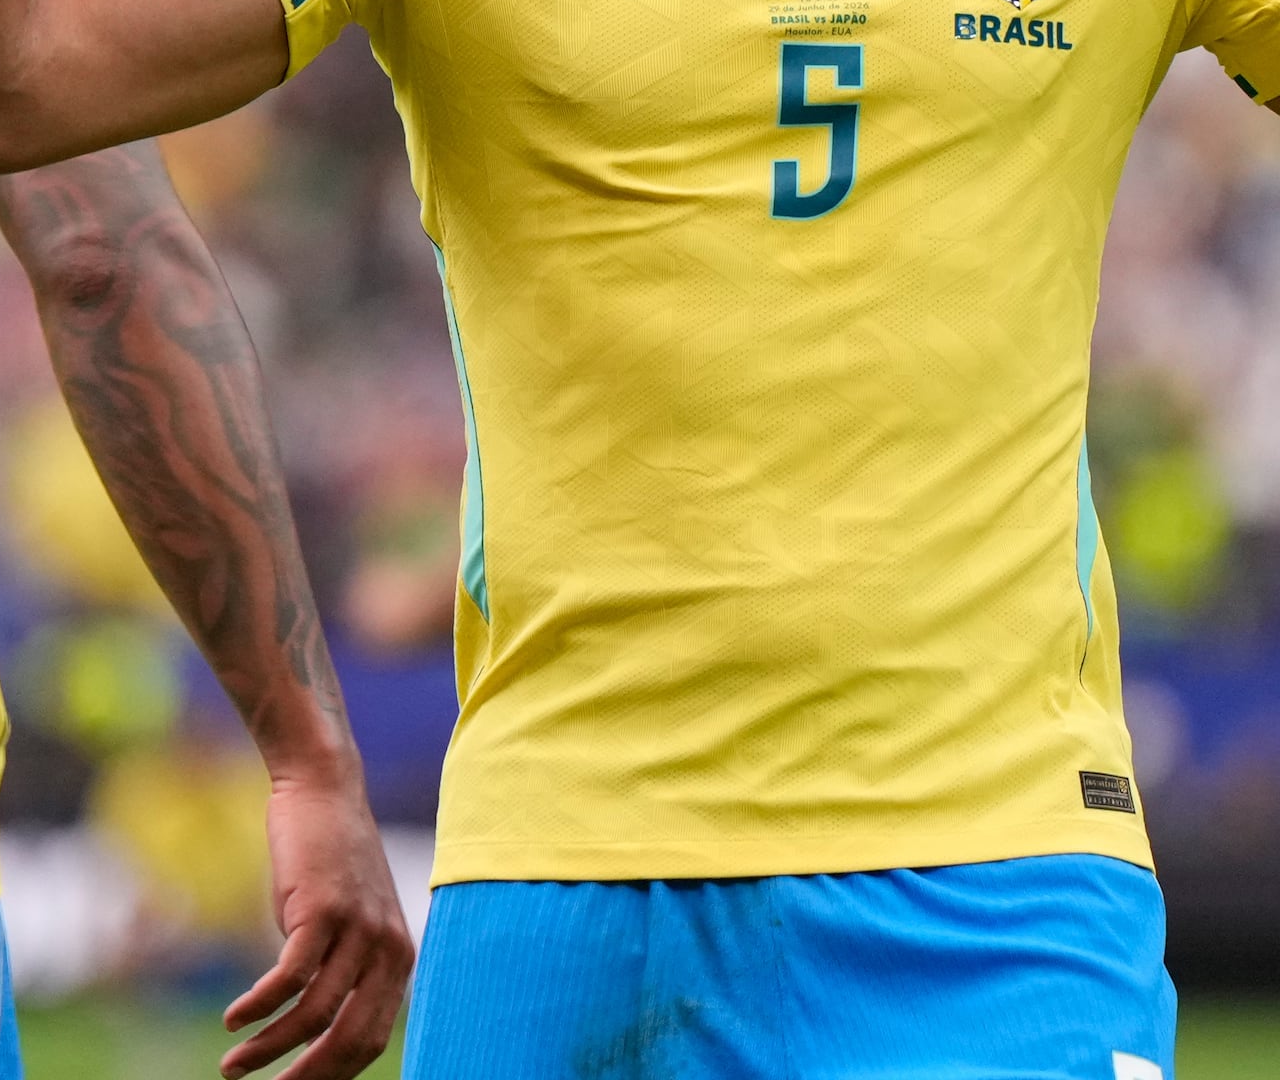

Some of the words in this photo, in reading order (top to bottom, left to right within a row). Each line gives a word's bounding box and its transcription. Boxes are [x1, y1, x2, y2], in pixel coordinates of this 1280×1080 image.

[830, 11, 867, 24] JAPÃO
[785, 27, 823, 36] Houston
[831, 27, 852, 36] EUA
[954, 12, 1073, 50] BRASIL
[770, 41, 864, 220] 5
